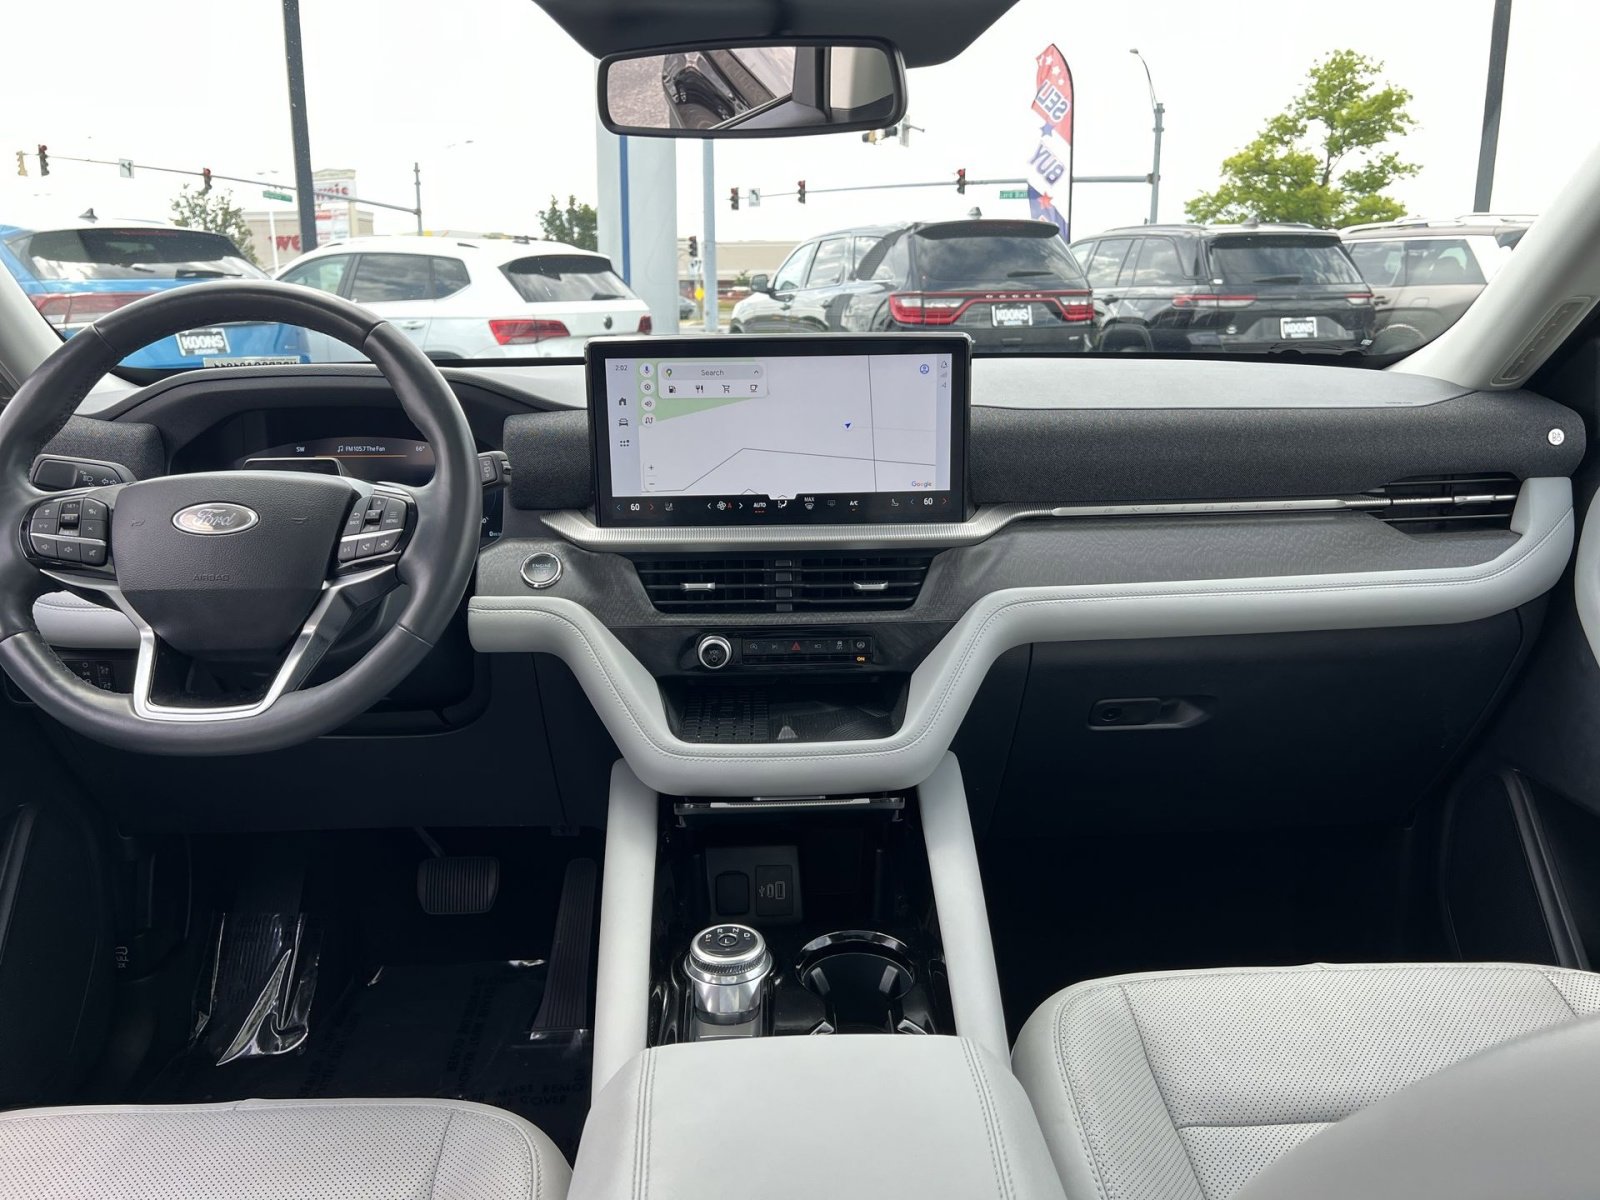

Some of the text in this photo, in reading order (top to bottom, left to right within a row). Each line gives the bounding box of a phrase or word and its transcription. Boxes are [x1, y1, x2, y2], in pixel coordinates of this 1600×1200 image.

[995, 308, 1029, 321] KOONS
[1284, 322, 1314, 334] KOONS
[181, 334, 225, 350] KOONS
[615, 364, 628, 372] 2:02
[701, 369, 725, 377] Search
[911, 480, 932, 488] Google
[630, 503, 640, 511] 60
[194, 508, 237, 526] Ford
[193, 574, 230, 582] AIRBAG
